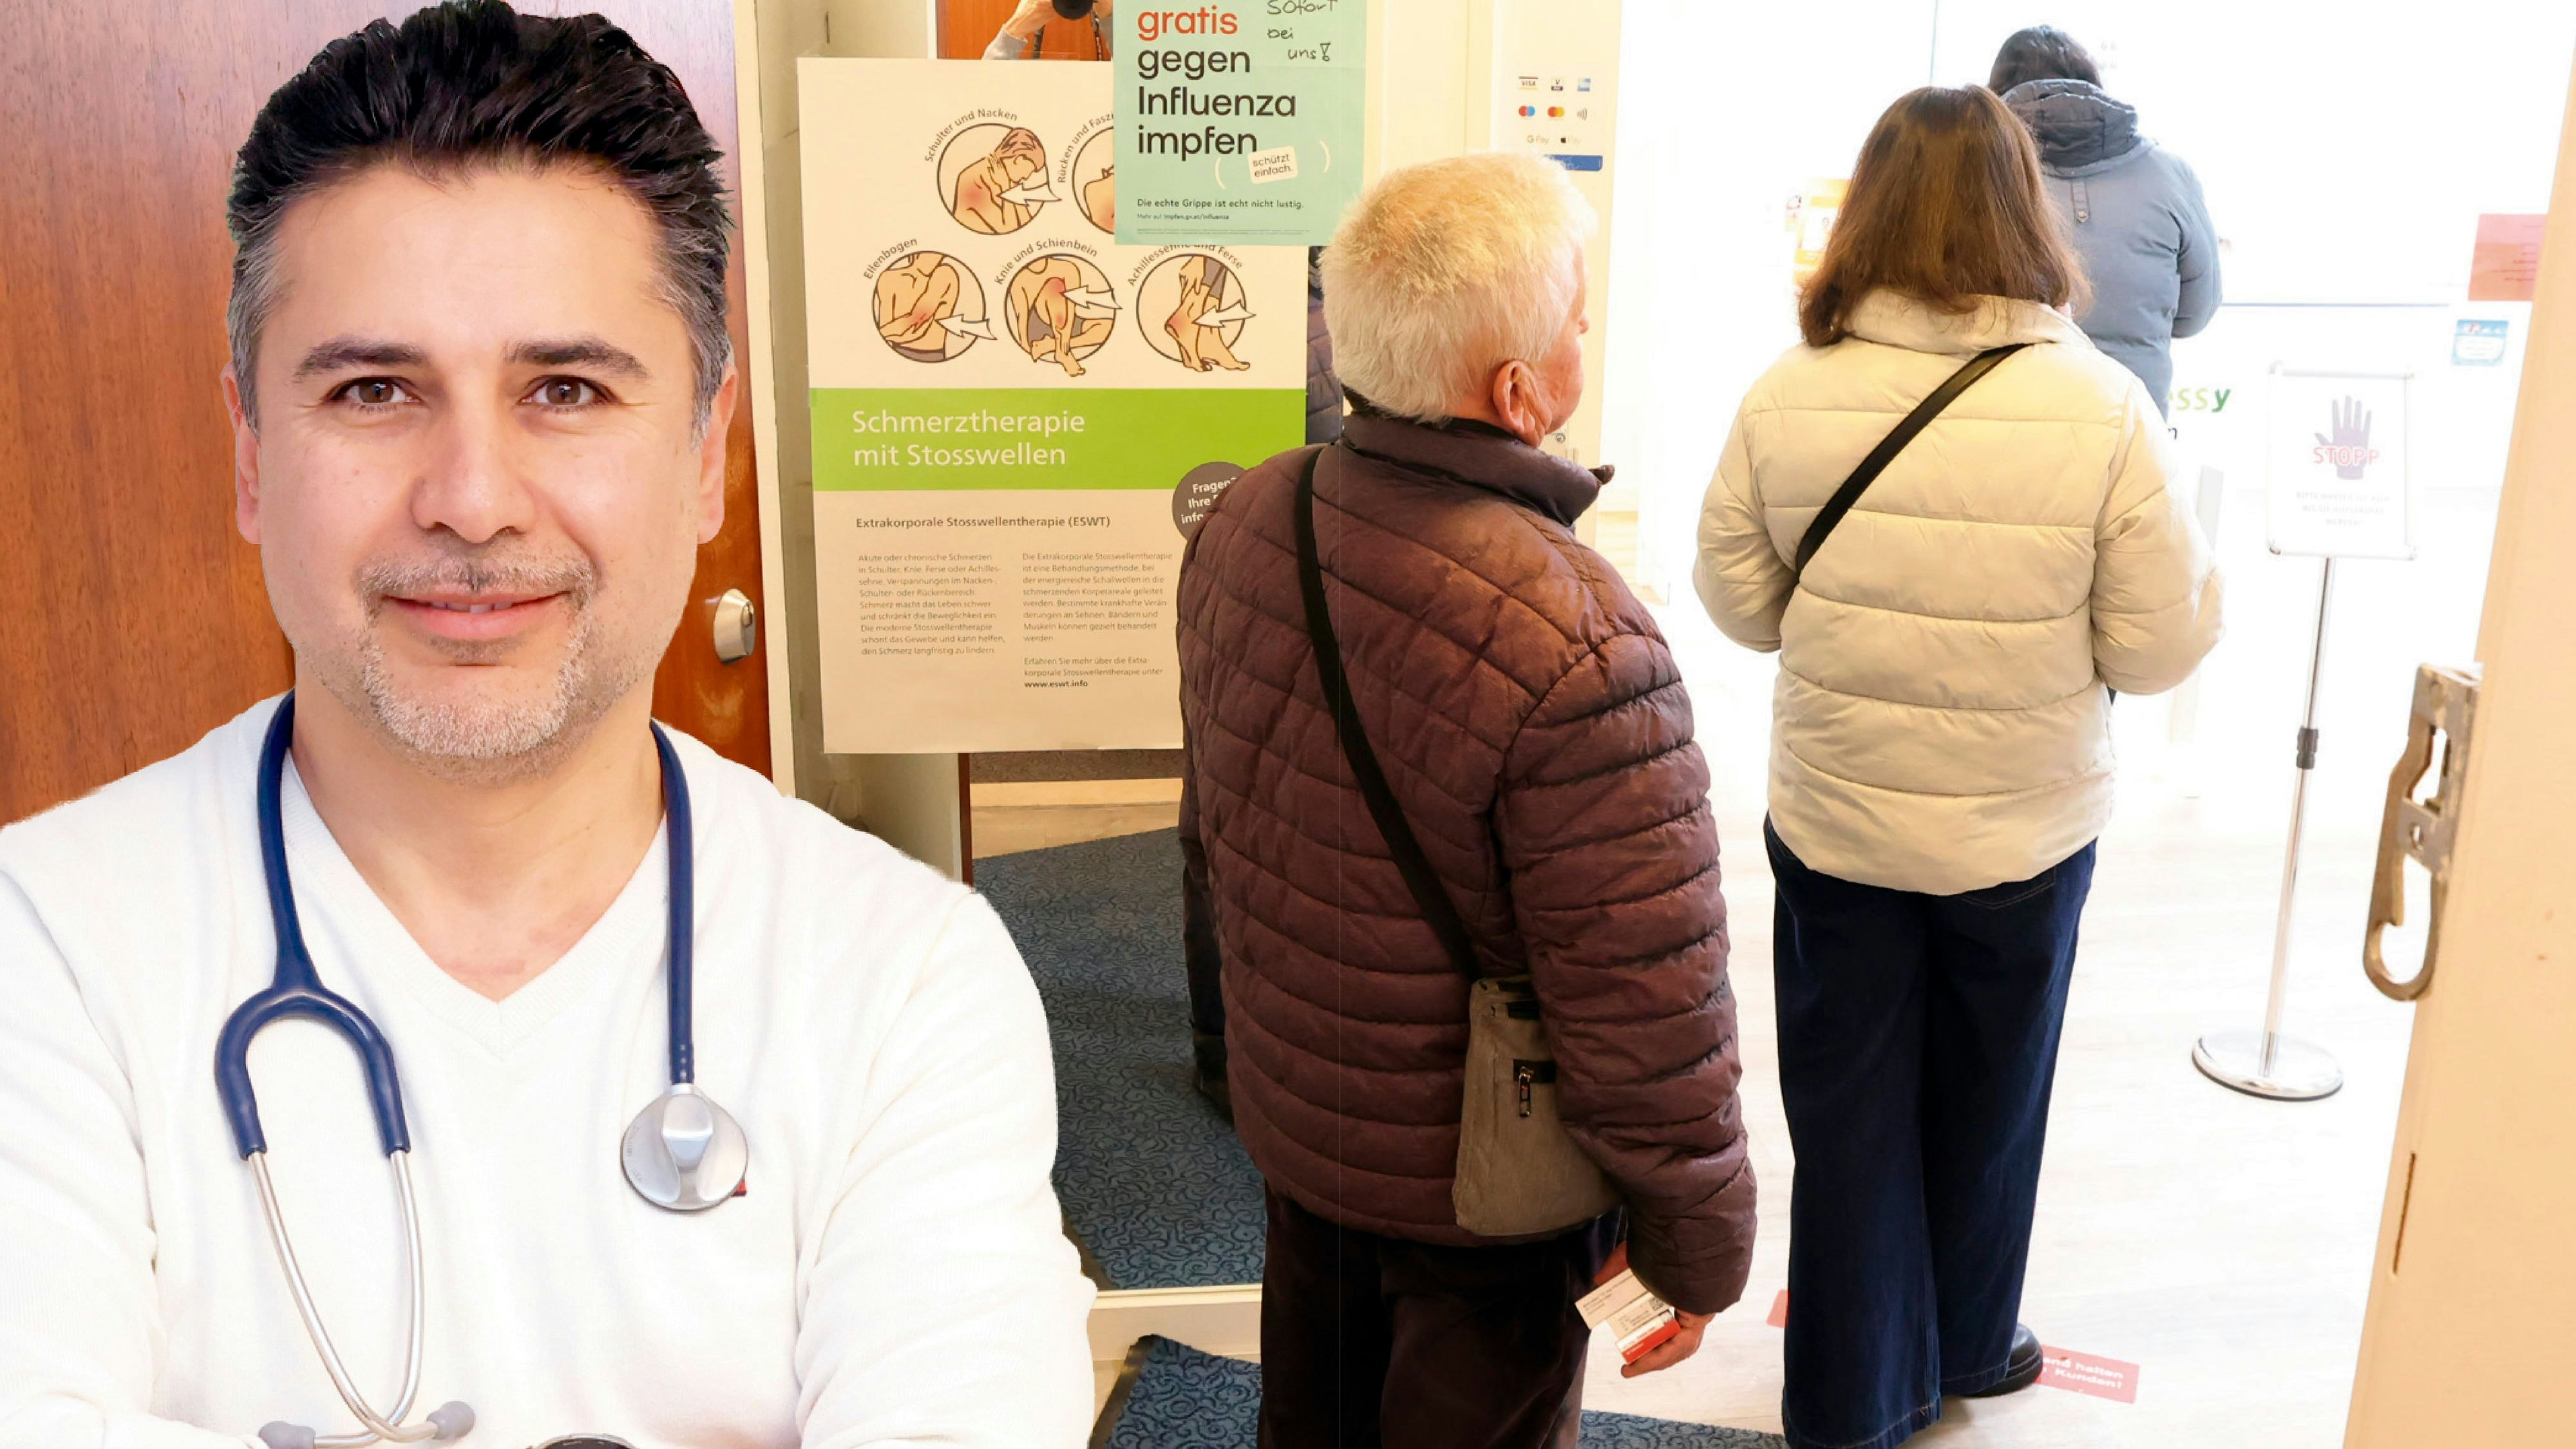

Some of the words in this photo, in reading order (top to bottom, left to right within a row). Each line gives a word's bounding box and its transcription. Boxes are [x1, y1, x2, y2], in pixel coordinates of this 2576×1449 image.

[1137, 5, 1238, 41] gratis
[1267, 28, 1294, 39] bei
[1138, 50, 1250, 80] gegen
[1139, 86, 1296, 117] Influenza
[925, 123, 954, 162] Schulter
[954, 111, 975, 126] und
[978, 108, 1018, 121] Nacken
[1139, 125, 1256, 161] impfen
[1057, 146, 1075, 183] Rücken
[1072, 124, 1090, 145] und
[1253, 154, 1290, 167] schützt
[1255, 165, 1293, 177] einfach.
[1137, 198, 1151, 207] Die
[1155, 199, 1179, 207] echte
[1182, 199, 1212, 209] Grippe
[1276, 200, 1304, 209] lustig.
[863, 238, 918, 279] Ellenbogen
[995, 261, 1016, 285] Knie
[1014, 244, 1034, 263] und
[1036, 238, 1098, 258] Schienbein
[1218, 247, 1243, 269] Ferse
[2168, 388, 2231, 413] ssy
[852, 410, 1085, 438] Schmerztherapie
[855, 444, 899, 466] mit
[907, 442, 1066, 466] Stosswellen
[2313, 446, 2380, 464] STOPP
[1188, 498, 1211, 509] Ihre
[857, 518, 943, 529] Extrakorporale
[947, 516, 1065, 527] Stosswellentherapie
[1068, 516, 1110, 527] (ESWT)
[1037, 553, 1094, 562] Extrakorporale
[1095, 553, 1172, 561] Stosswellentherapie
[887, 577, 949, 587] Verspannungen
[928, 612, 981, 621] Beweglichkeit
[914, 623, 992, 632] Stosswellentherapie
[1089, 622, 1115, 630] gezielt
[914, 647, 953, 656] langfristig
[1024, 668, 1061, 677] korporale
[1063, 668, 1140, 676] Stosswellentherapie
[2076, 1362, 2123, 1378] halten
